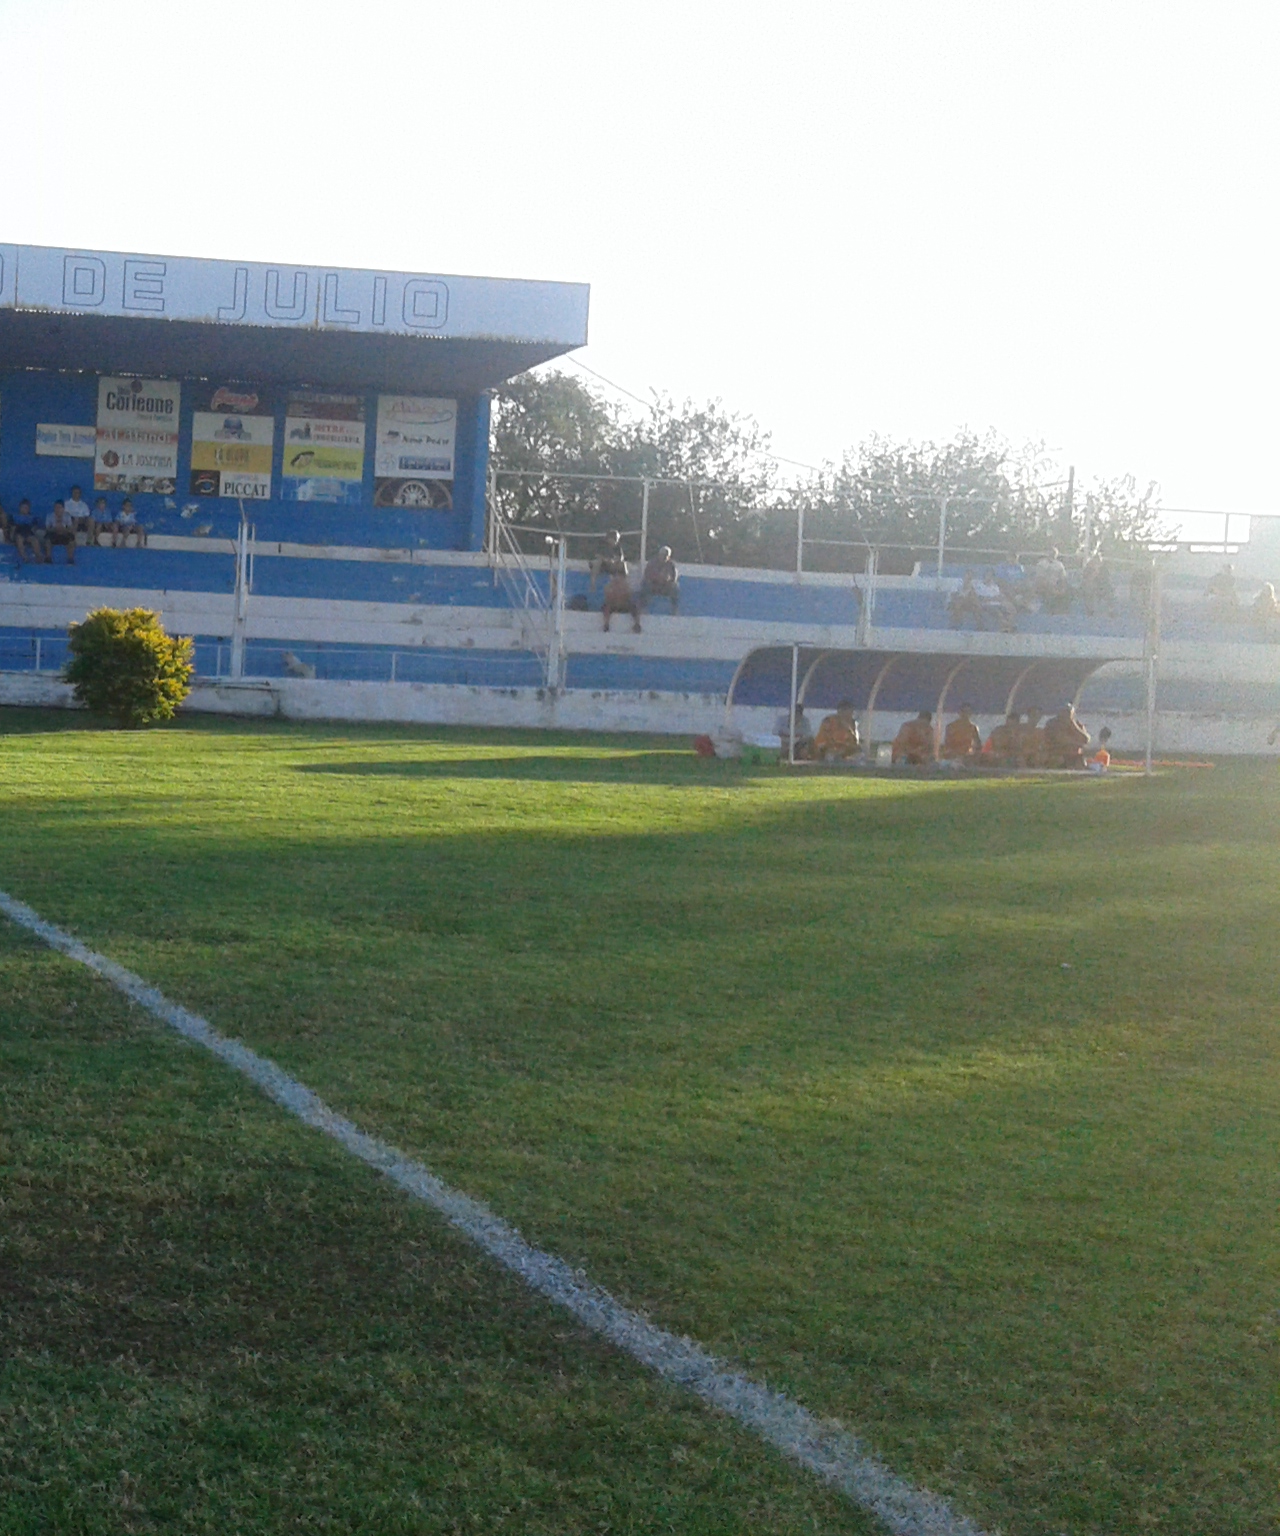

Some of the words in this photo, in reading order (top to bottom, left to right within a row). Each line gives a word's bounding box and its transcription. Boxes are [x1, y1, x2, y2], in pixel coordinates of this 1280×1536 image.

[61, 254, 167, 312] DE
[217, 266, 450, 329] JULIO
[106, 391, 174, 415] Corleone
[121, 454, 133, 466] LA
[223, 481, 268, 497] PICCAT
